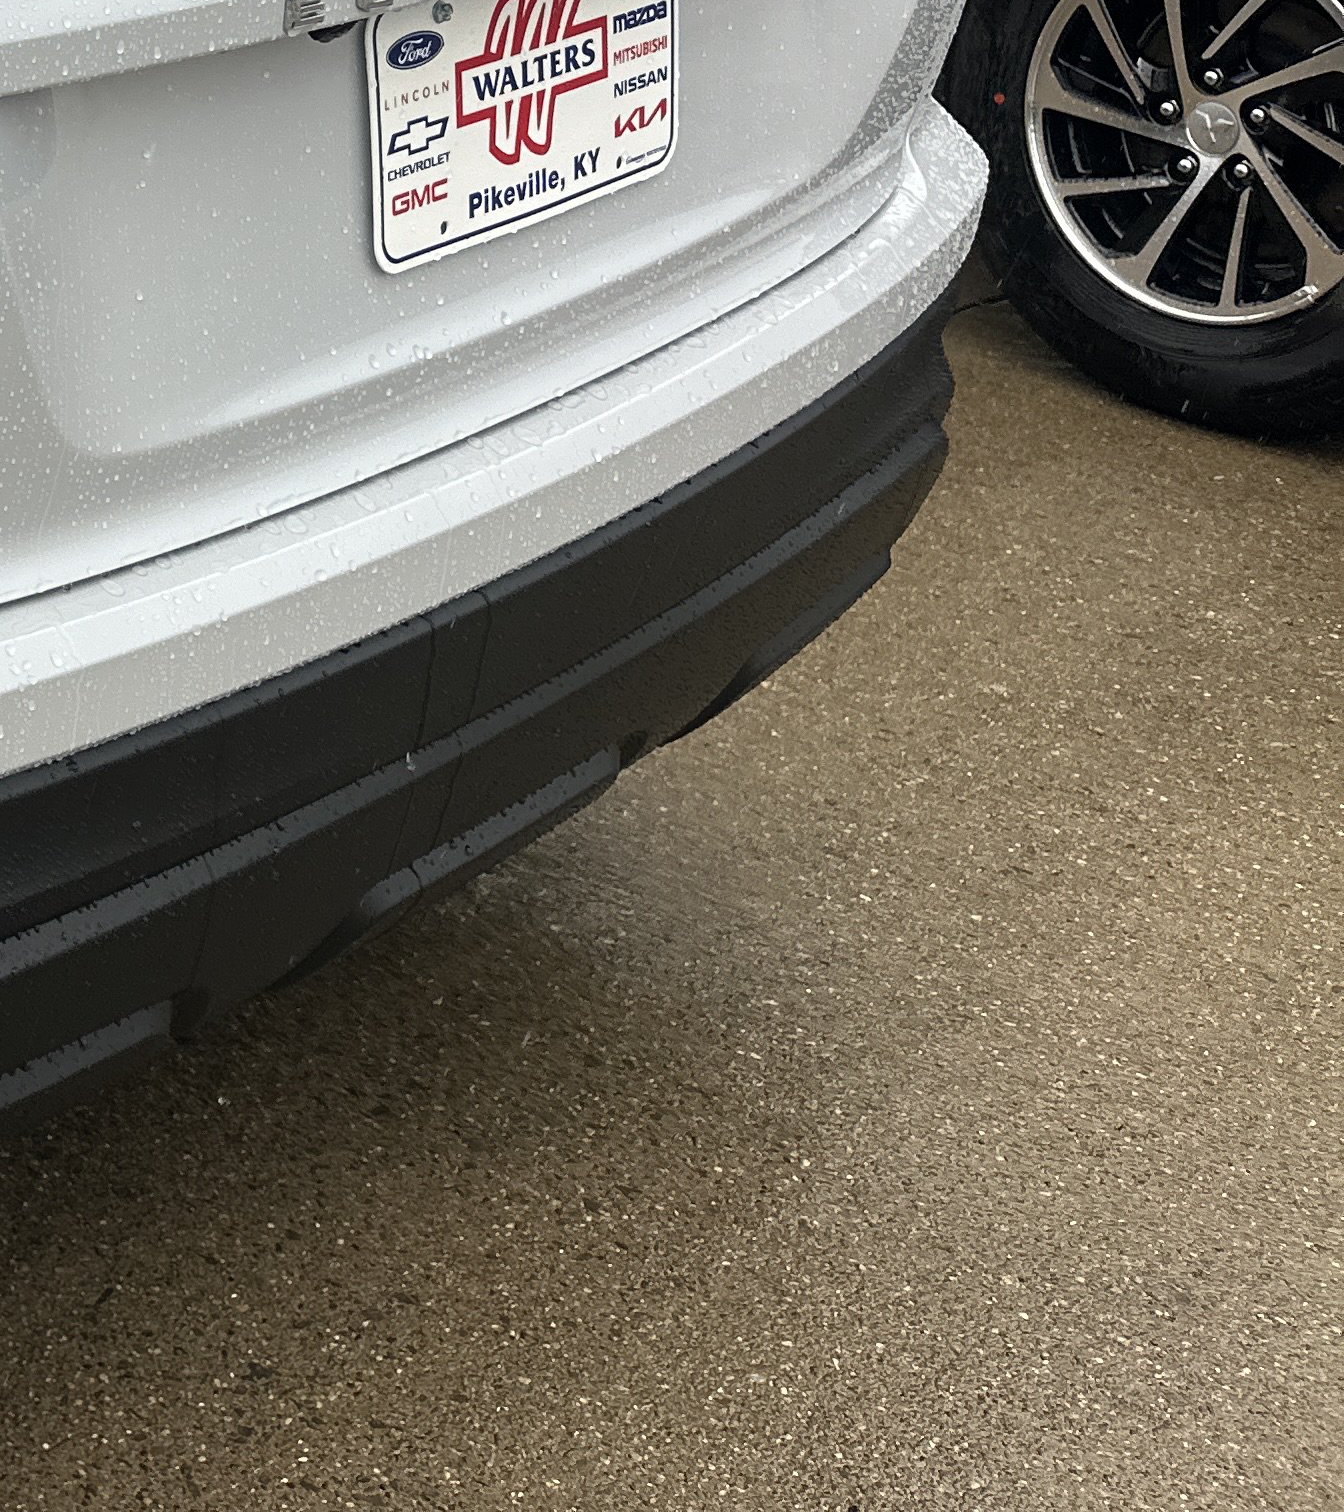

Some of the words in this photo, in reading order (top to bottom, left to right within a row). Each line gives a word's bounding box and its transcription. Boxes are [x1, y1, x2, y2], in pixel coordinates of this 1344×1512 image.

[613, 0, 668, 35] mazda
[398, 38, 433, 65] Ford
[613, 35, 668, 66] MITSUBISHI
[472, 38, 596, 102] WALTERS
[613, 66, 668, 98] NISSAN
[384, 80, 450, 112] LINCOLN
[614, 98, 668, 139] KIA
[387, 152, 451, 182] CHEVROLET
[469, 168, 565, 219] Pikeville,
[574, 147, 601, 180] KY
[392, 178, 448, 216] GMC
